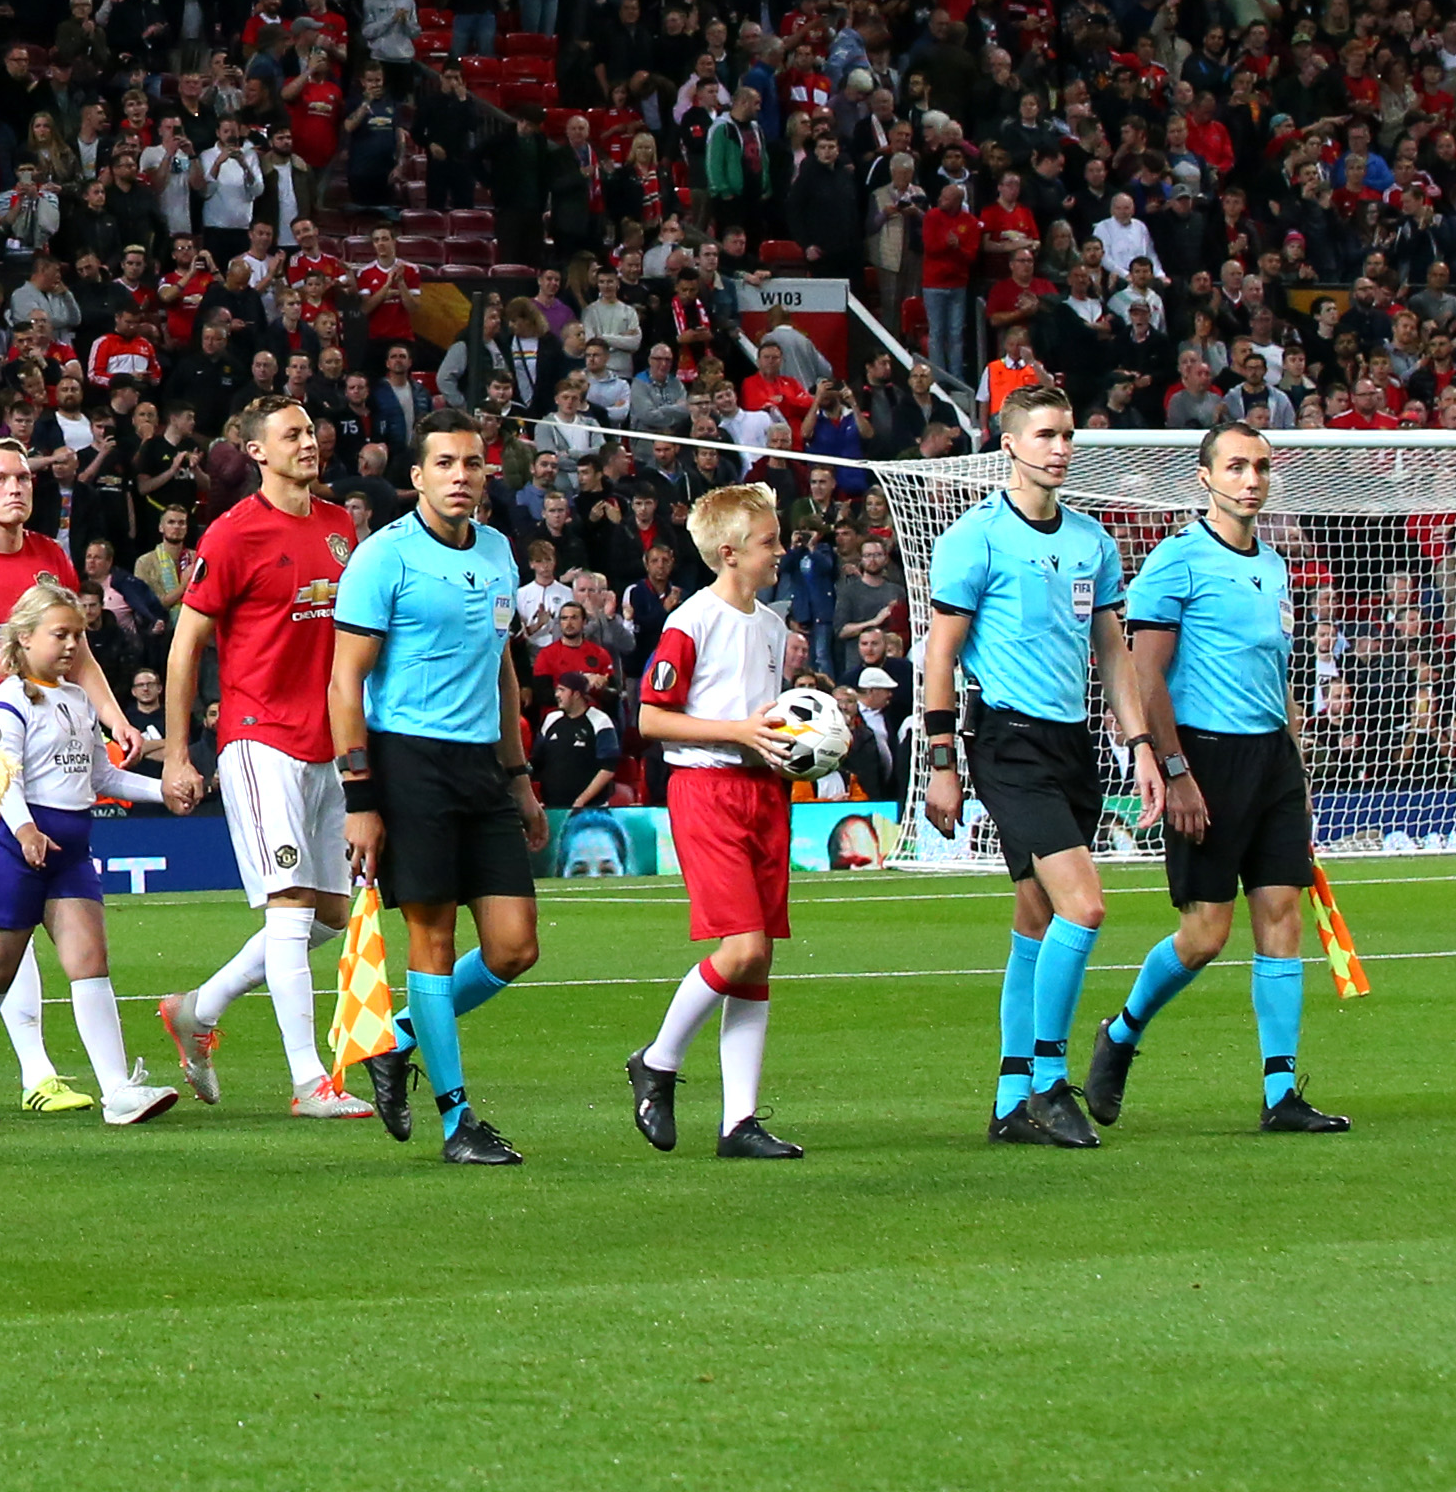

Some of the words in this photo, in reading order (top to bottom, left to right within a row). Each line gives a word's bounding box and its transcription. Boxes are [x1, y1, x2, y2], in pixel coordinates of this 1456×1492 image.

[760, 291, 803, 306] W103
[340, 420, 359, 435] 75
[1073, 583, 1091, 593] FIFA
[292, 607, 335, 622] CHEVRO
[54, 754, 90, 766] EUROPA
[63, 766, 88, 775] LEAGUE
